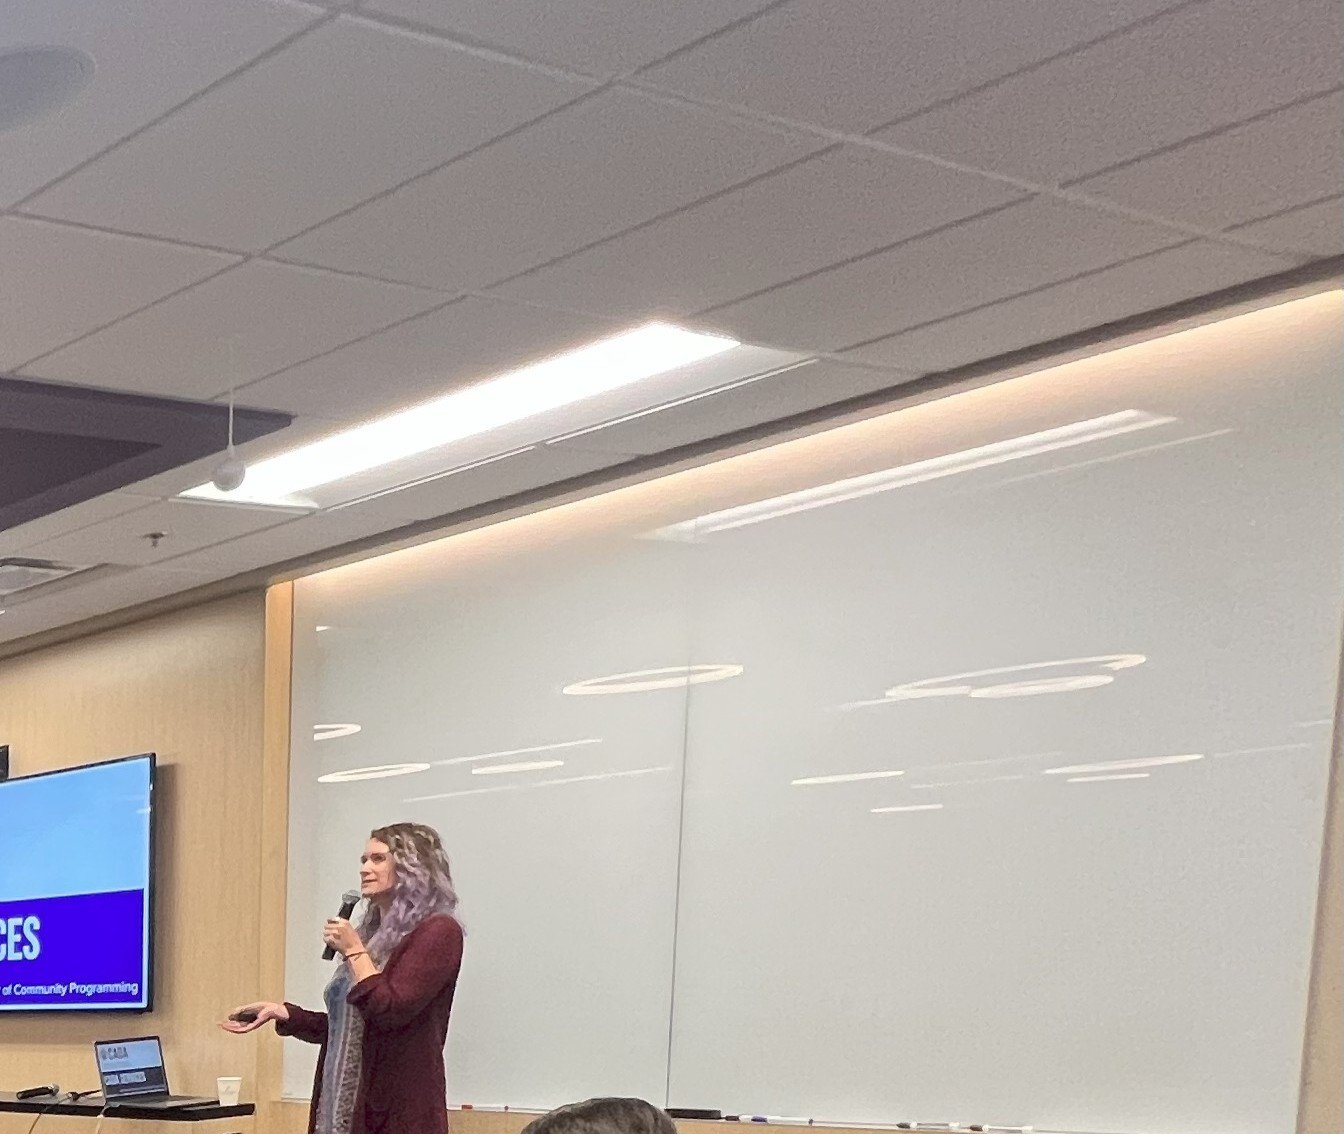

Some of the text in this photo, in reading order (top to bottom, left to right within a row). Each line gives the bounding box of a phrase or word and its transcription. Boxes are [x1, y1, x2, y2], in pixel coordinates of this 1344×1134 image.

[2, 984, 12, 996] of
[13, 983, 68, 997] Community
[69, 981, 139, 997] Programming
